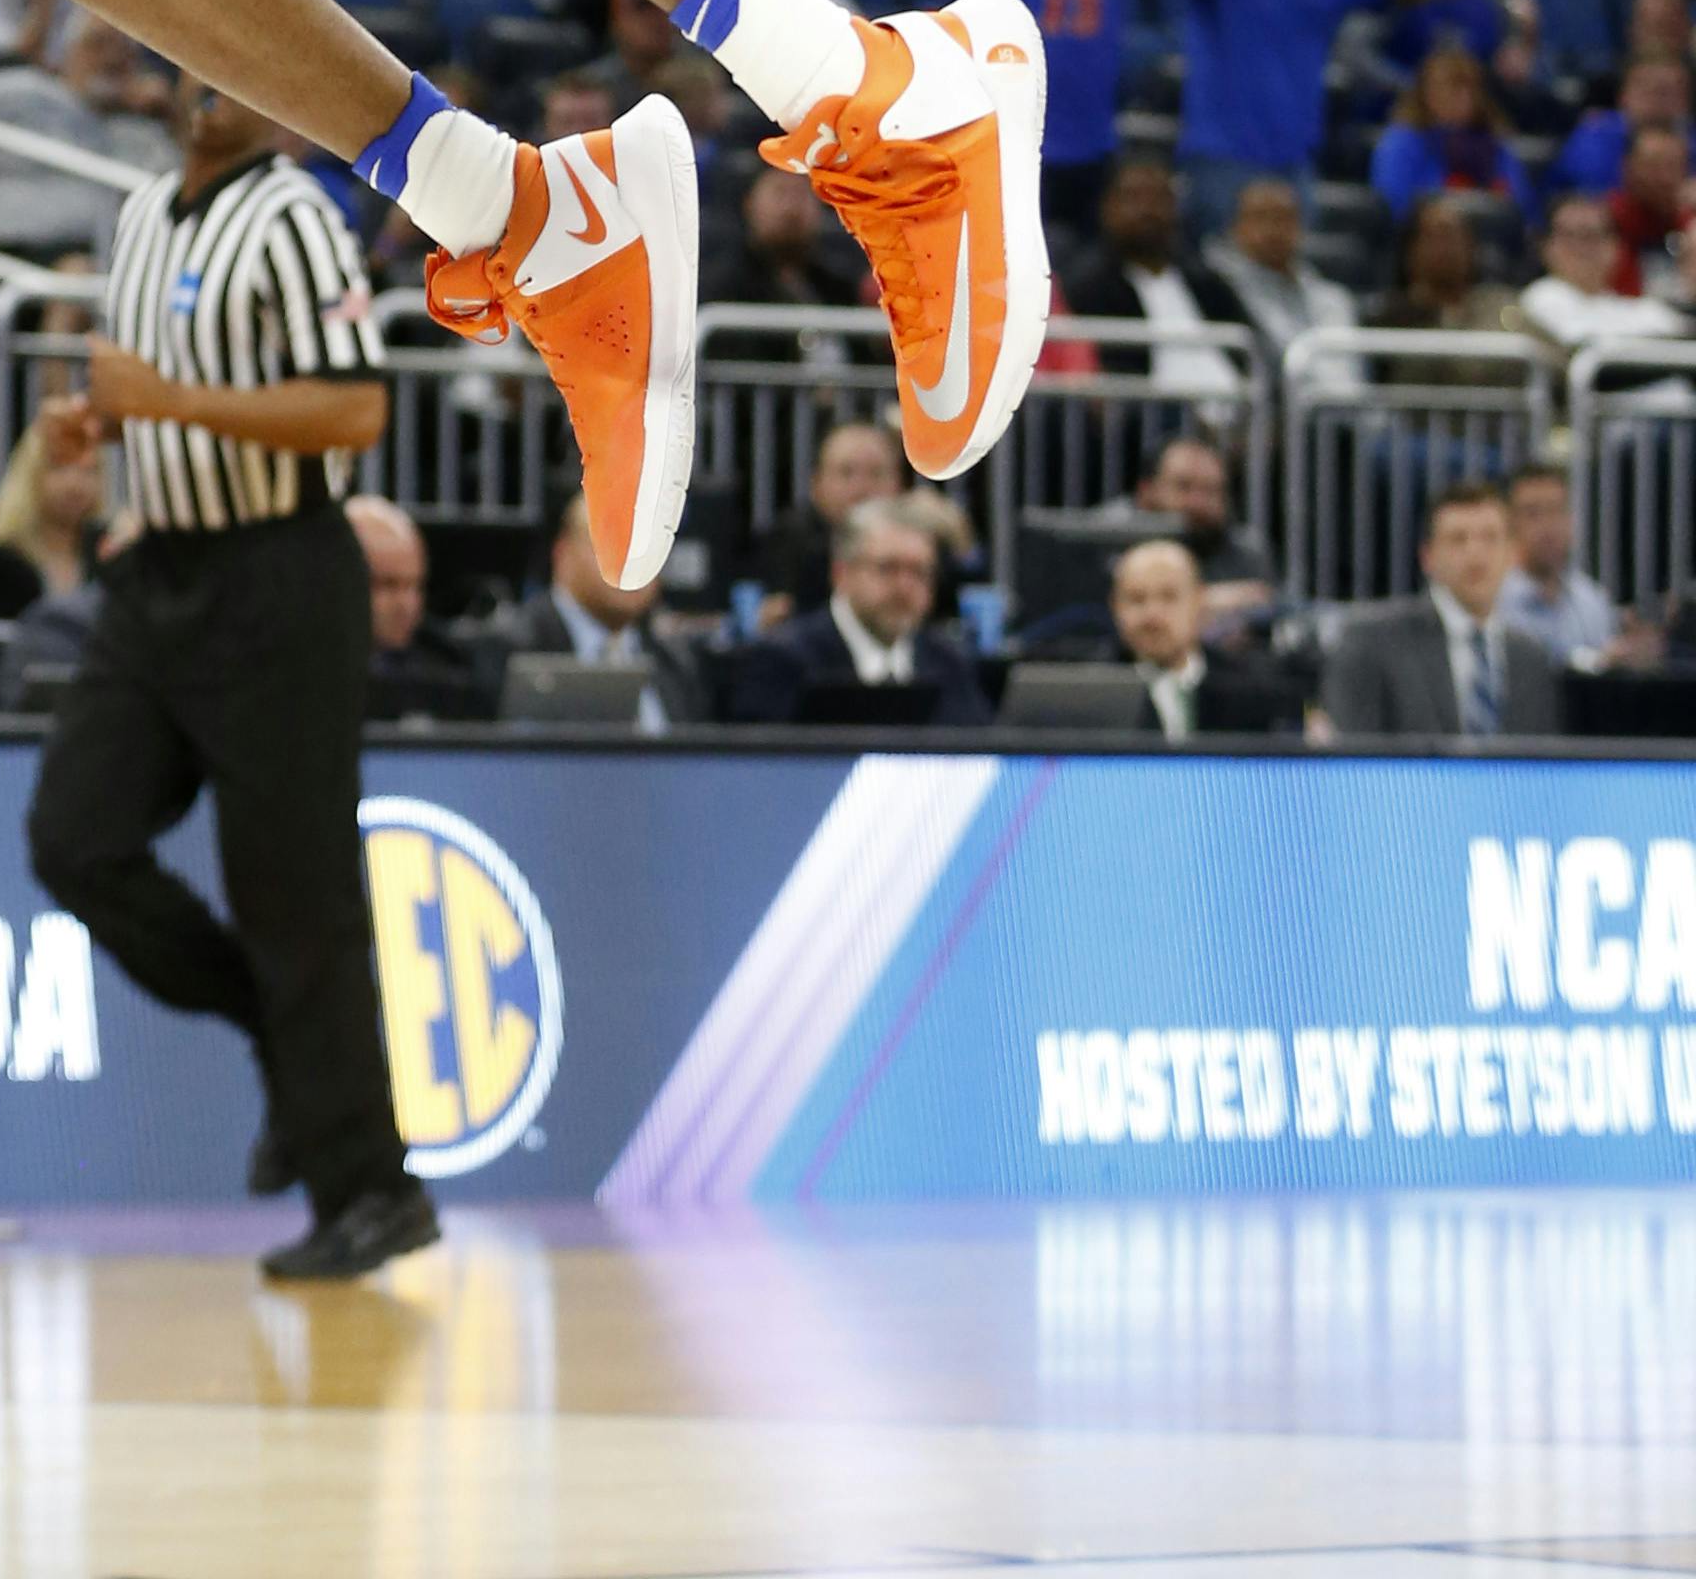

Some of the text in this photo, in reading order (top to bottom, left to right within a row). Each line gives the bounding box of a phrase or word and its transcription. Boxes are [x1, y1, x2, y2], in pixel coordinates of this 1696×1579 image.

[364, 828, 537, 1145] EC
[1036, 1028, 1286, 1145] HOSTED
[1293, 1026, 1380, 1141] BY
[1388, 1025, 1657, 1140] STETSON
